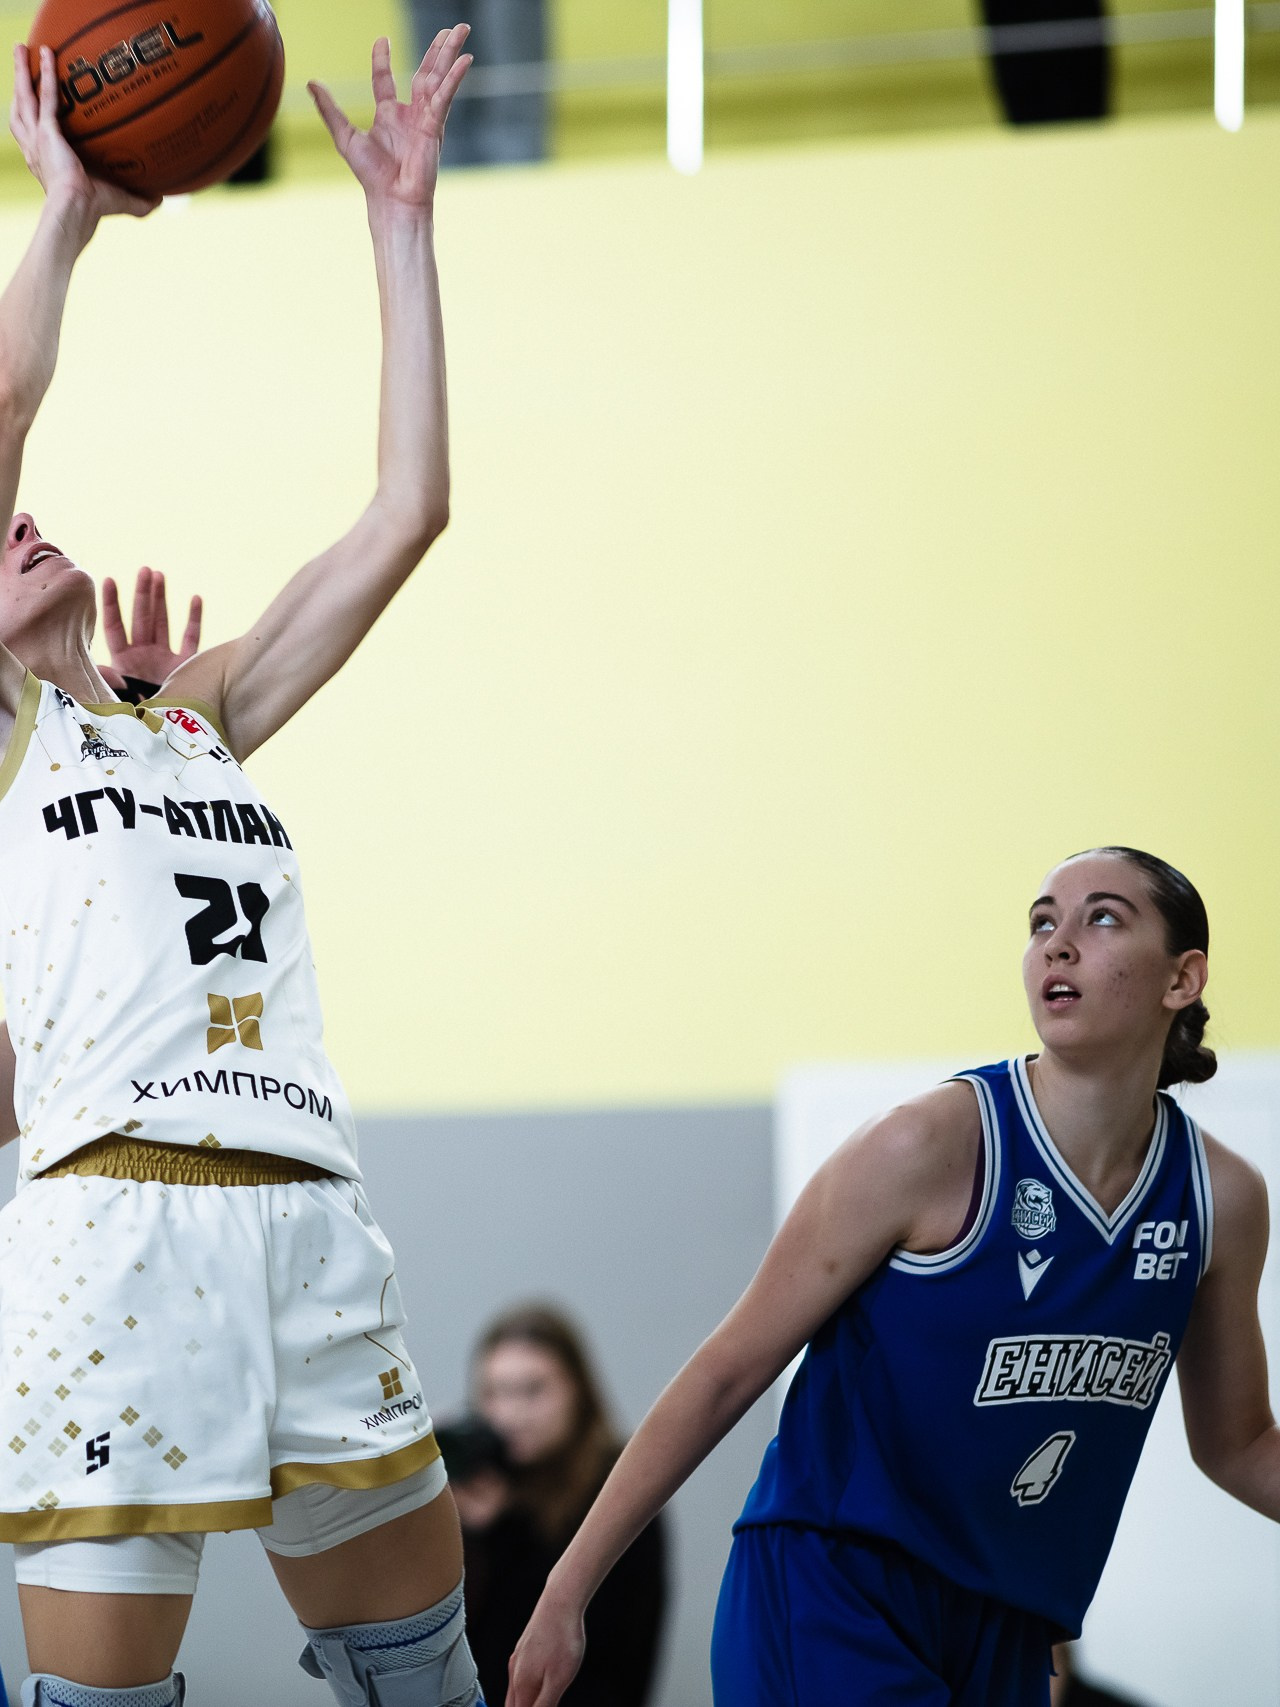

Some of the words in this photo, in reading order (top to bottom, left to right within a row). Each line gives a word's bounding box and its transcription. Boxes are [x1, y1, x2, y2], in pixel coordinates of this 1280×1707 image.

[41, 786, 294, 851] ЧГУ-АТЛАН
[173, 872, 271, 966] 21
[130, 1068, 334, 1123] ХИМПРОМ
[1133, 1251, 1189, 1280] BET
[973, 1331, 1172, 1410] ЕНИСЕЙ
[360, 1391, 423, 1430] ХИМПРО
[1009, 1430, 1077, 1508] 4
